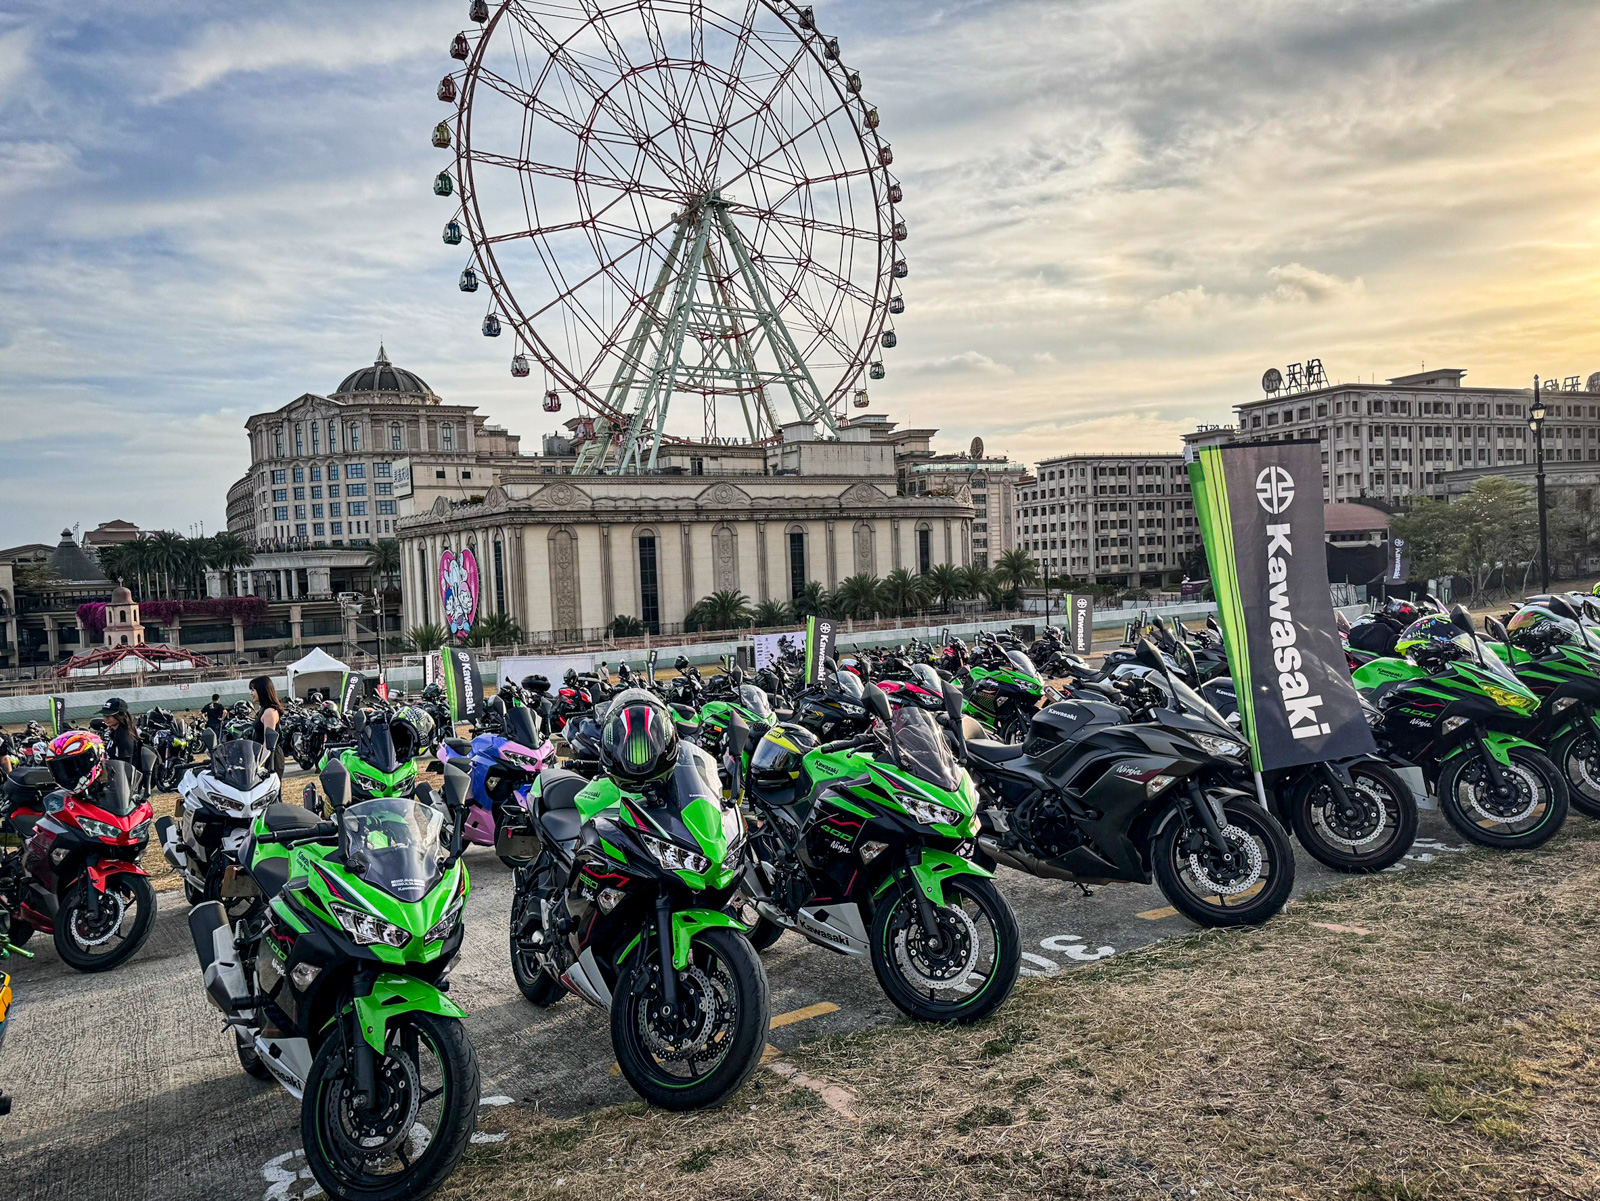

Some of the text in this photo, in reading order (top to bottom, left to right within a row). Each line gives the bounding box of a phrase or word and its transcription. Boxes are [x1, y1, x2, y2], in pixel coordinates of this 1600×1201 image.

[1077, 609, 1086, 651] Kawasaki
[1266, 523, 1331, 739] Kawasaki
[817, 635, 829, 681] Kawasaki
[1377, 667, 1403, 677] Kawasaki
[461, 663, 476, 715] Kawasaki
[1048, 708, 1078, 721] Kawasaki
[1398, 707, 1437, 719] 400
[1410, 718, 1432, 728] Ninja
[814, 759, 839, 774] Kawasaki
[1116, 764, 1143, 777] Ninja
[820, 824, 854, 842] 400
[830, 840, 851, 854] Ninja
[799, 918, 850, 947] Kawasaki
[265, 936, 288, 962] 400
[271, 957, 287, 977] Ninja
